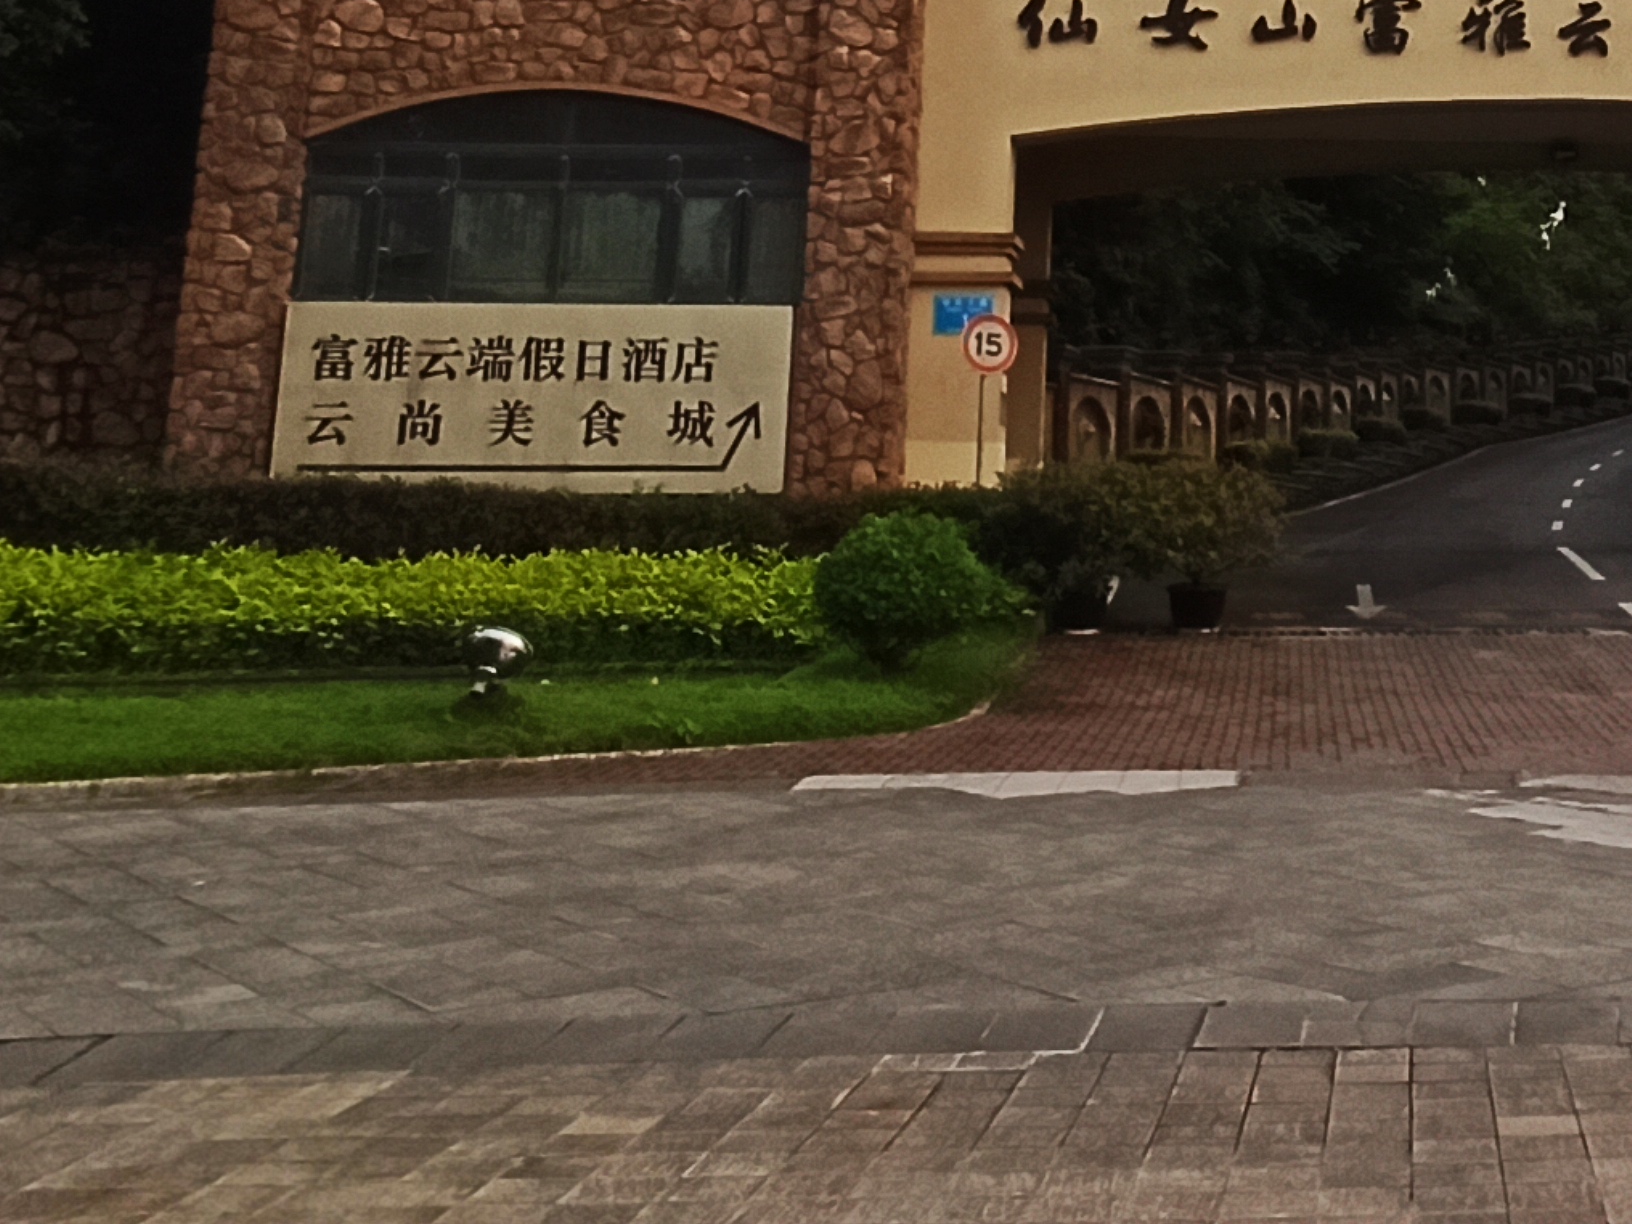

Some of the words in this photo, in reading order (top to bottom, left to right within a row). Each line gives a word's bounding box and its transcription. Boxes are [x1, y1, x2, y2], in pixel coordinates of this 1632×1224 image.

[311, 334, 720, 384] 富雅云端假日酒店
[974, 330, 1003, 357] 15
[305, 398, 715, 448] 云尚美食城
